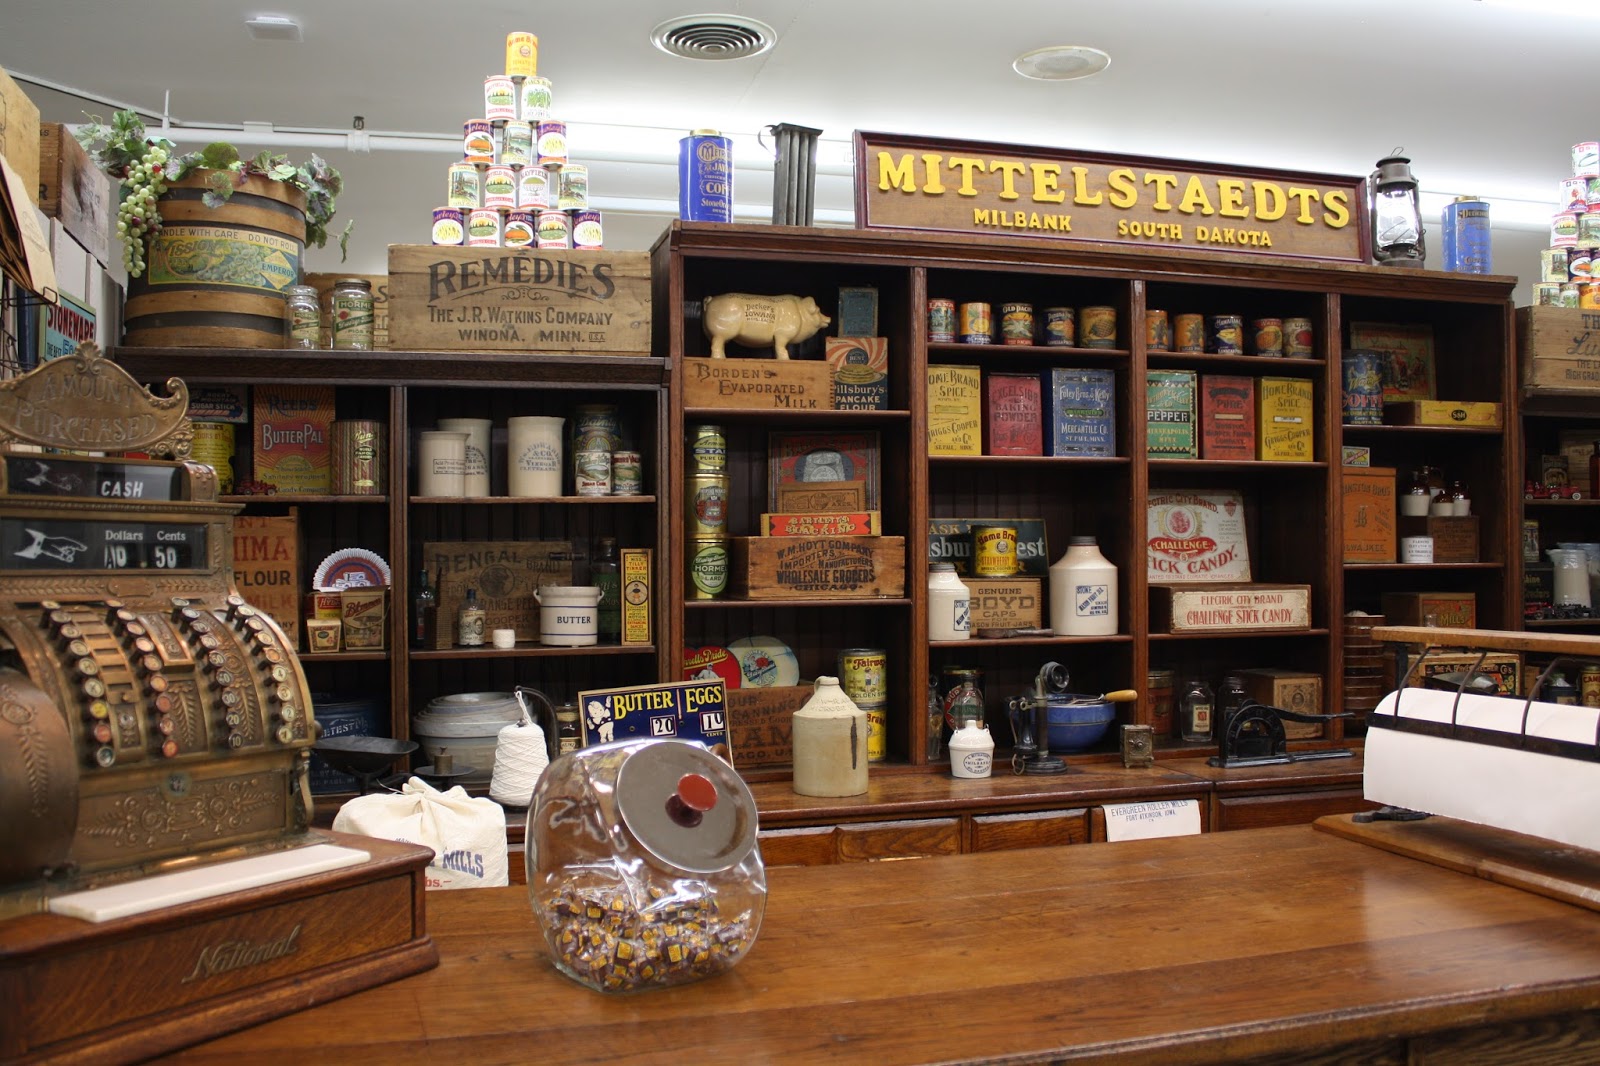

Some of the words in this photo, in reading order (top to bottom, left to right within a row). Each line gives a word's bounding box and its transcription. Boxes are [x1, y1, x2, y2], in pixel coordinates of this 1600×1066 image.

[878, 152, 1350, 228] MITTELSTAEDTS
[974, 208, 1072, 232] MILBANK
[159, 227, 185, 237] ANDLE
[189, 229, 211, 237] WITH
[248, 233, 261, 242] DO
[264, 236, 279, 246] NOT
[1118, 220, 1182, 239] SOUTH
[1196, 226, 1272, 246] DAKOTA
[262, 262, 296, 278] EMPEROR
[428, 256, 615, 302] REMEDIES
[427, 304, 453, 323] THE
[488, 307, 542, 324] WATKINS
[545, 307, 612, 325] COMPANY
[47, 306, 94, 341] STONEWARE
[540, 330, 585, 342] MINN.
[696, 362, 772, 382] BORDEN'S
[928, 373, 950, 385] OME
[950, 370, 979, 390] BRAND
[41, 374, 136, 408] AMOUNT
[718, 380, 805, 396] EVAPORATED
[940, 386, 967, 398] SPICE
[1060, 386, 1075, 400] Foley
[1095, 388, 1110, 402] Kelly
[1262, 384, 1286, 400] HOME
[1286, 382, 1312, 400] BRAND
[774, 394, 817, 409] MILK
[996, 404, 1036, 412] BAKING
[1278, 397, 1299, 408] SPICE
[16, 402, 156, 446] PURCHASED
[994, 412, 1038, 422] POWDER
[1147, 411, 1188, 422] PEPPER
[952, 420, 978, 434] COOPER
[1061, 422, 1098, 434] MERCANTILE
[101, 480, 144, 498] CASH
[1148, 496, 1174, 508] ECTRIC
[1175, 493, 1192, 503] CITY
[234, 517, 268, 528] NT
[785, 524, 856, 535] BLACKING
[928, 525, 960, 535] ASK
[105, 530, 144, 540] Dollars
[156, 530, 186, 542] Cents
[977, 532, 1002, 544] Home
[1017, 537, 1046, 557] est
[1154, 540, 1209, 550] CHALLENGE
[155, 546, 177, 569] 50
[1187, 543, 1238, 574] CANDY.
[234, 570, 290, 587] FLOUR
[776, 570, 830, 584] WHOLESALE
[833, 569, 876, 582] GROCERS
[969, 596, 1035, 610] BOYD
[1201, 596, 1234, 606] ELECTRIC
[1236, 595, 1252, 605] CITY
[1254, 594, 1283, 605] BRAND
[556, 616, 592, 625] BUTTER
[1186, 610, 1233, 626] CHALLENGE
[1236, 609, 1260, 624] STICK
[1262, 608, 1296, 624] CANDY.
[1440, 613, 1465, 626] MILLS
[703, 648, 728, 662] Pride
[612, 691, 674, 720] BUTTER
[684, 686, 722, 713] EGGS
[732, 700, 796, 718] CANNING
[228, 714, 240, 726] 20
[655, 718, 674, 733] 20
[232, 736, 242, 746] 10
[1111, 804, 1146, 817] EVERGREEN
[1147, 802, 1170, 812] ROLLER
[1171, 799, 1188, 808] MILLS
[1164, 809, 1176, 817] IOWA
[442, 850, 484, 879] MILLS
[181, 924, 301, 984] National
